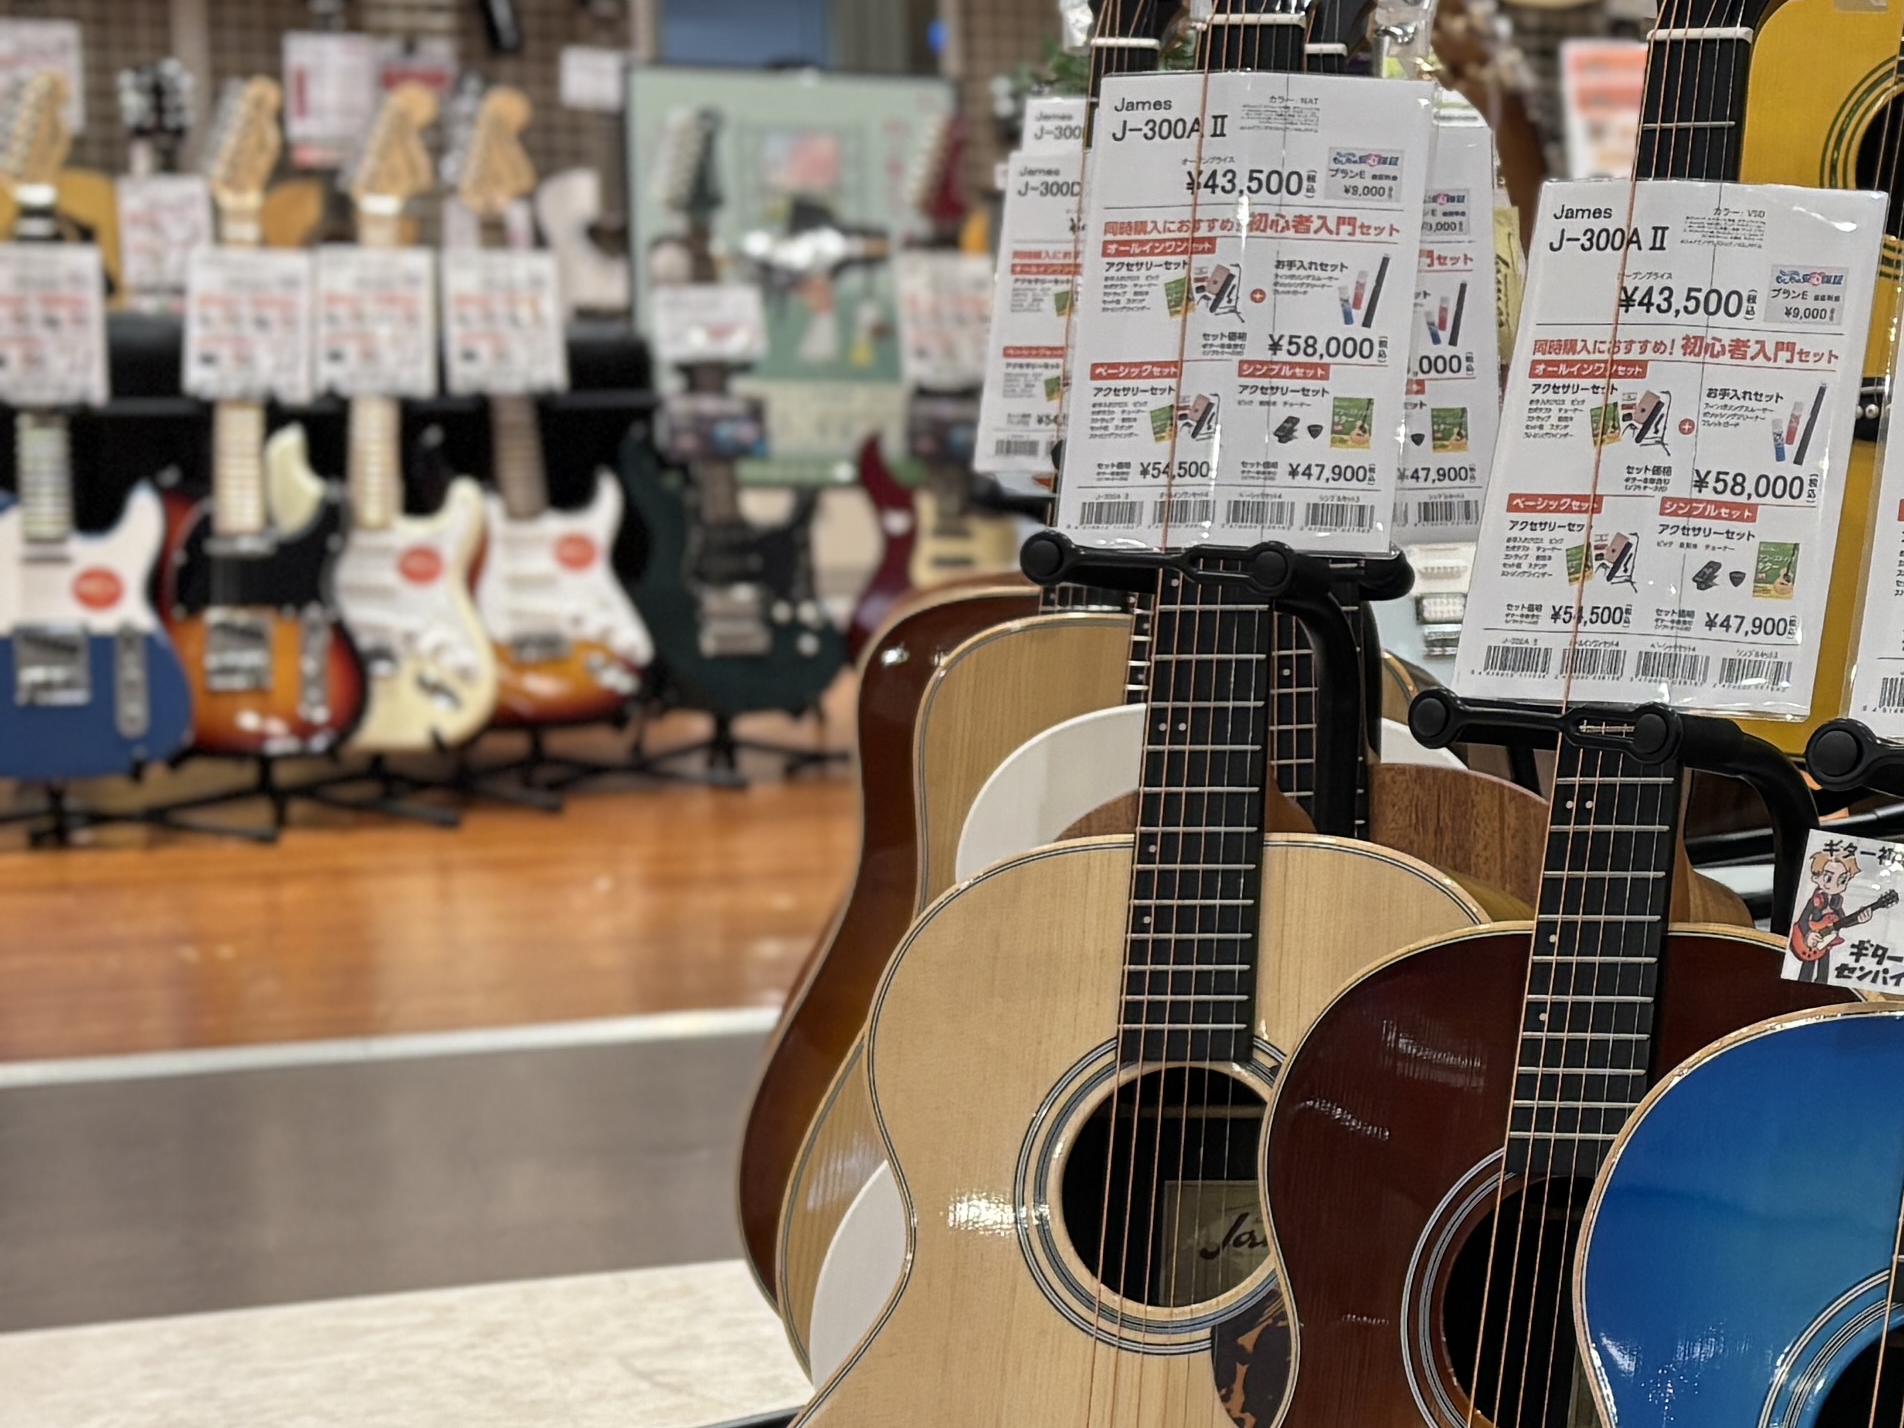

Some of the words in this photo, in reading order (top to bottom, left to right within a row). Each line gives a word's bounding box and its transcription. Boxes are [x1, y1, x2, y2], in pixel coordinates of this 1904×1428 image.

[1114, 97, 1173, 112] James
[1112, 116, 1201, 140] J-300A
[1186, 169, 1302, 196] ¥43,500
[1553, 205, 1612, 220] James
[1549, 228, 1642, 251] J-300A
[1618, 286, 1743, 318] ¥43,500
[1268, 334, 1374, 359] ¥58,000
[1288, 463, 1367, 482] ¥47,900
[1693, 469, 1805, 500] ¥58,000
[1705, 613, 1789, 637] ¥47,900
